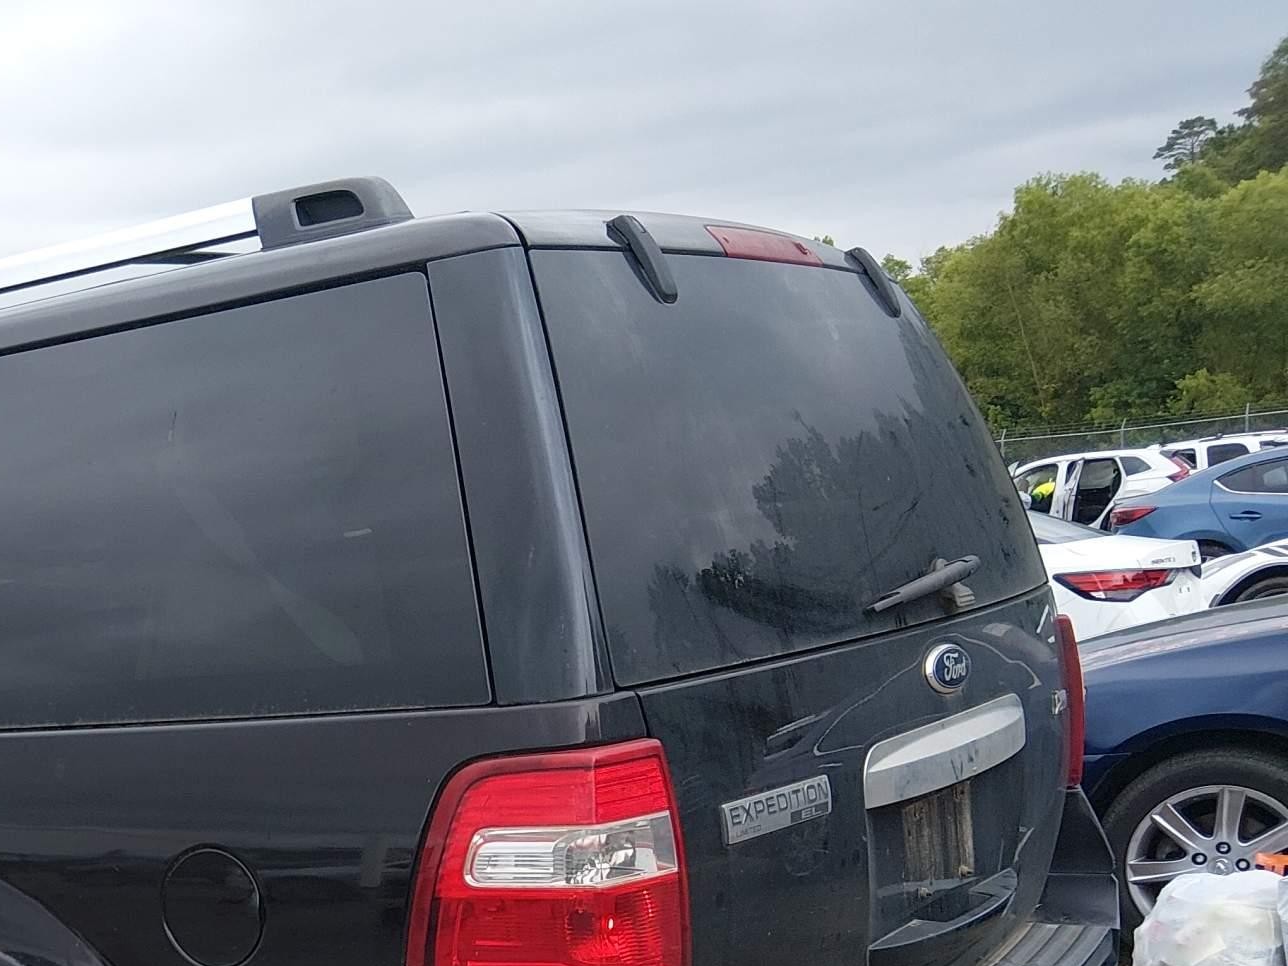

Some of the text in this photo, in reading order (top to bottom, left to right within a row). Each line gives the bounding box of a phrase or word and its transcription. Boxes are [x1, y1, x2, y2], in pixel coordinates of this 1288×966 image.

[943, 652, 967, 681] Ford
[729, 780, 829, 826] EXPEDITION
[801, 807, 823, 820] EL
